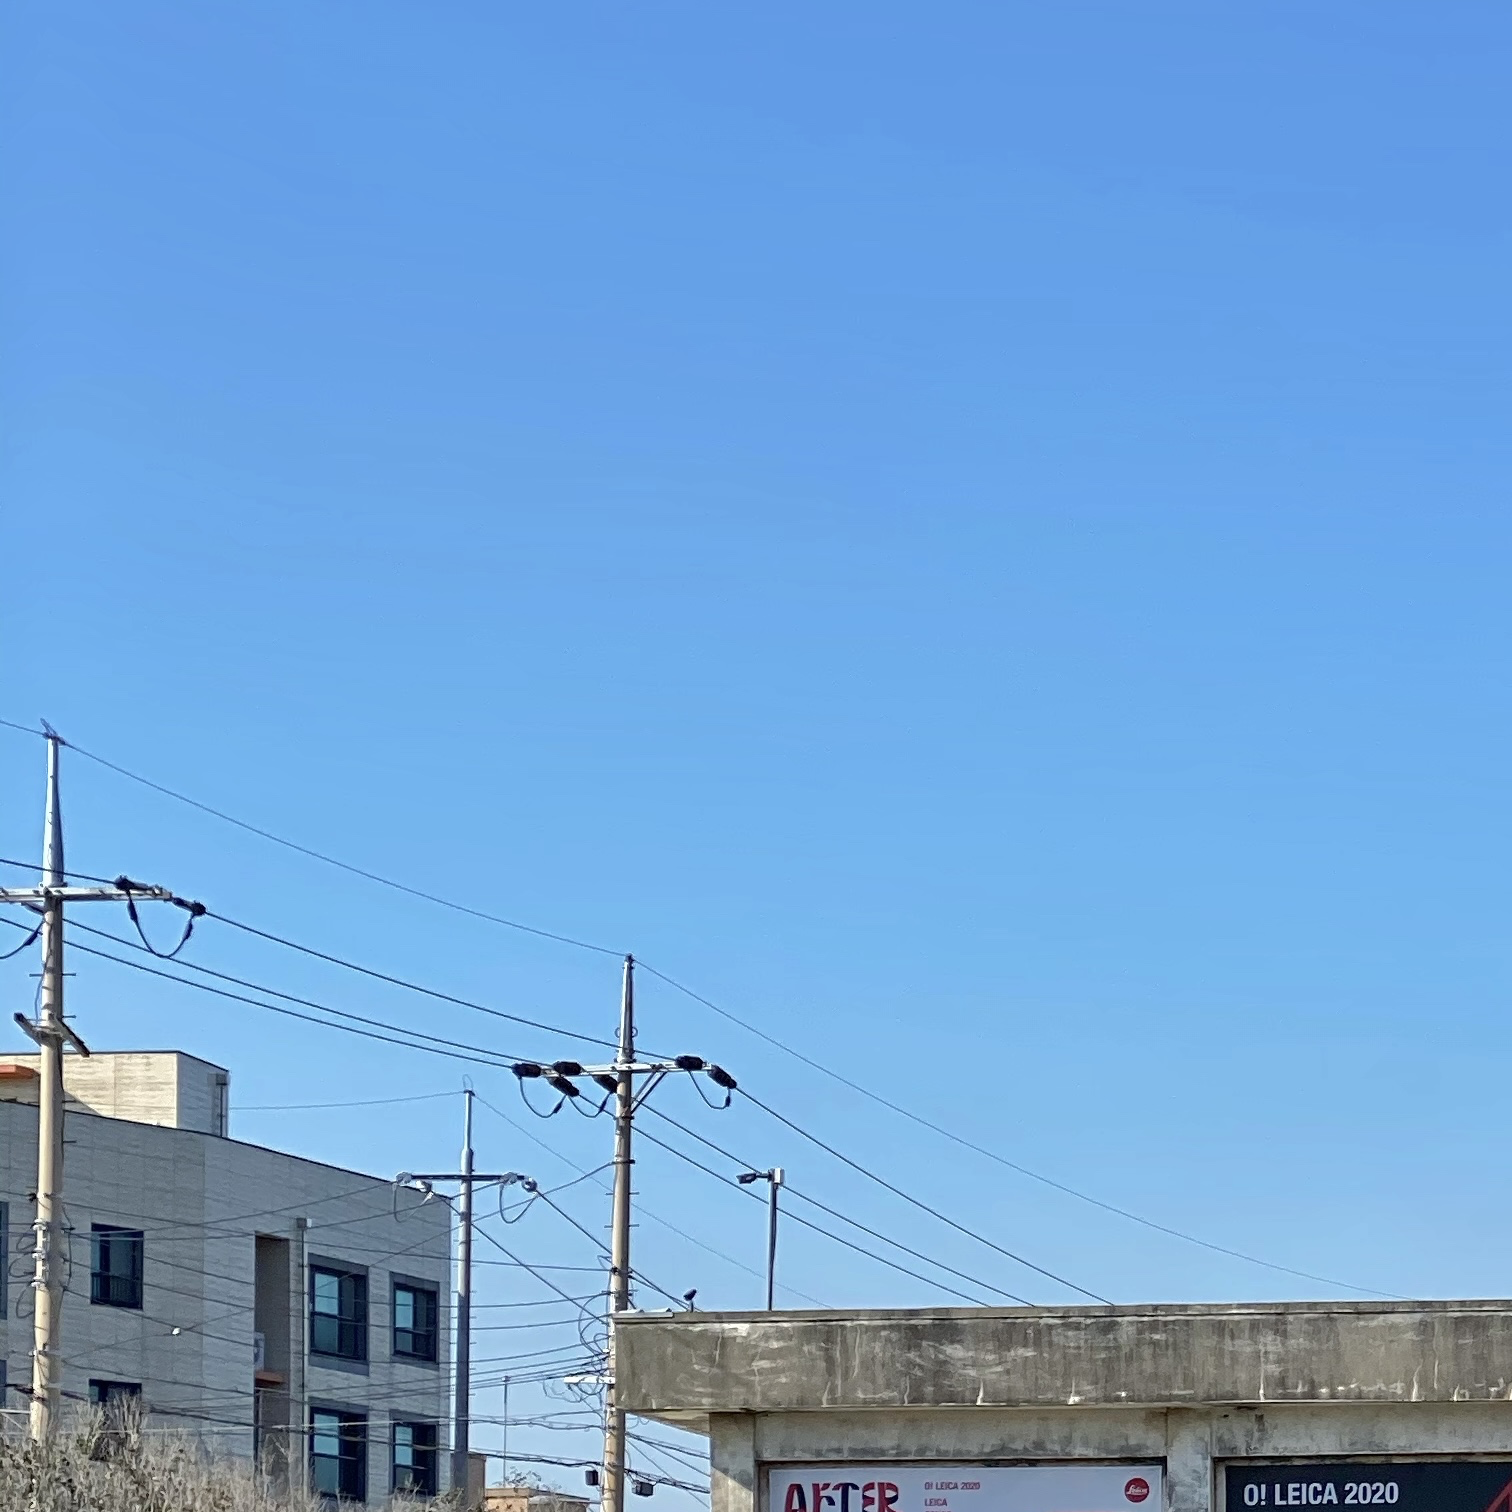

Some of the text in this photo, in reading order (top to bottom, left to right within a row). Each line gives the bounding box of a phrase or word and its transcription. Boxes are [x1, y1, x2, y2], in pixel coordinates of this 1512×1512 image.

[935, 1481, 958, 1491] LEICA
[960, 1481, 981, 1490] 2020
[1243, 1481, 1399, 1506] O! LEICA 2020
[924, 1498, 948, 1507] LEICA
